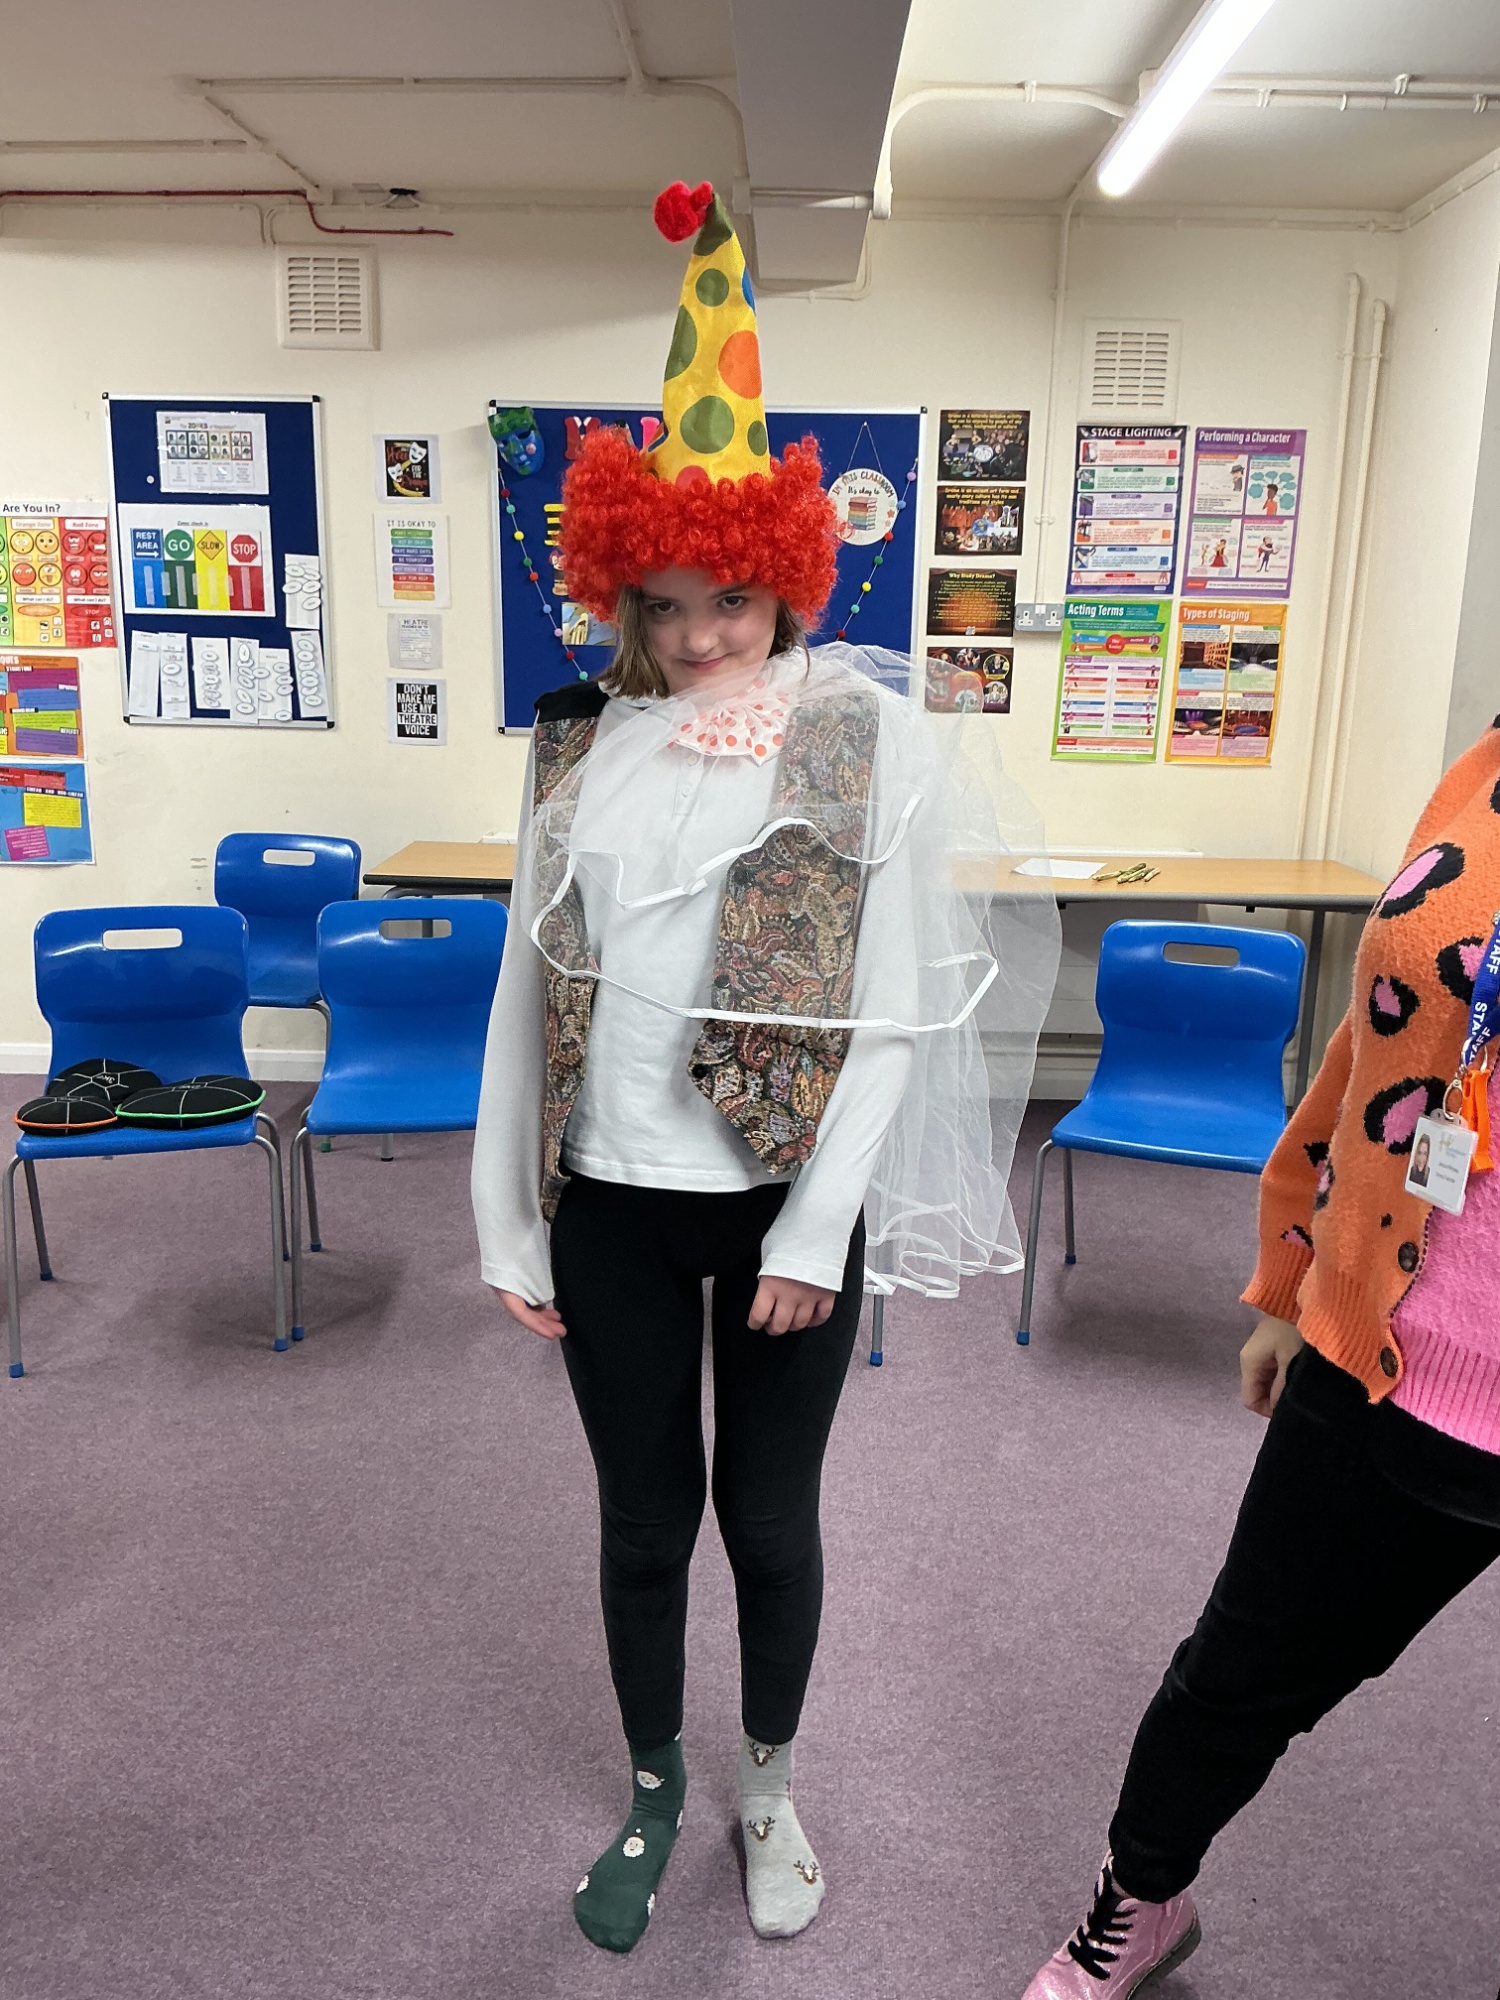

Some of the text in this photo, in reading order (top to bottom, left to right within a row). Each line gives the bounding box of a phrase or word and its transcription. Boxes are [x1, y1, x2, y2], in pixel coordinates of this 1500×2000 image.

[1091, 428, 1171, 437] STAGE LIGHTING
[1199, 431, 1244, 444] Performing
[1251, 432, 1291, 443] Character
[861, 471, 894, 497] CLASSROOM
[3, 504, 61, 514] Are You In?
[136, 532, 157, 540] REST
[168, 540, 190, 551] GO
[201, 542, 220, 550] SLOW
[233, 544, 257, 555] STOP
[1068, 604, 1096, 617] Acting
[1098, 605, 1124, 616] Terms
[1183, 608, 1250, 622] Types of Staging
[404, 684, 429, 694] DON'T
[398, 693, 436, 704] MAKE ME
[402, 703, 432, 713] USE MY
[399, 714, 436, 724] THEATRE
[405, 724, 430, 735] VOICE
[1486, 931, 1500, 975] AFF
[1472, 1001, 1488, 1036] STA
[1469, 1027, 1491, 1064] TAFF
